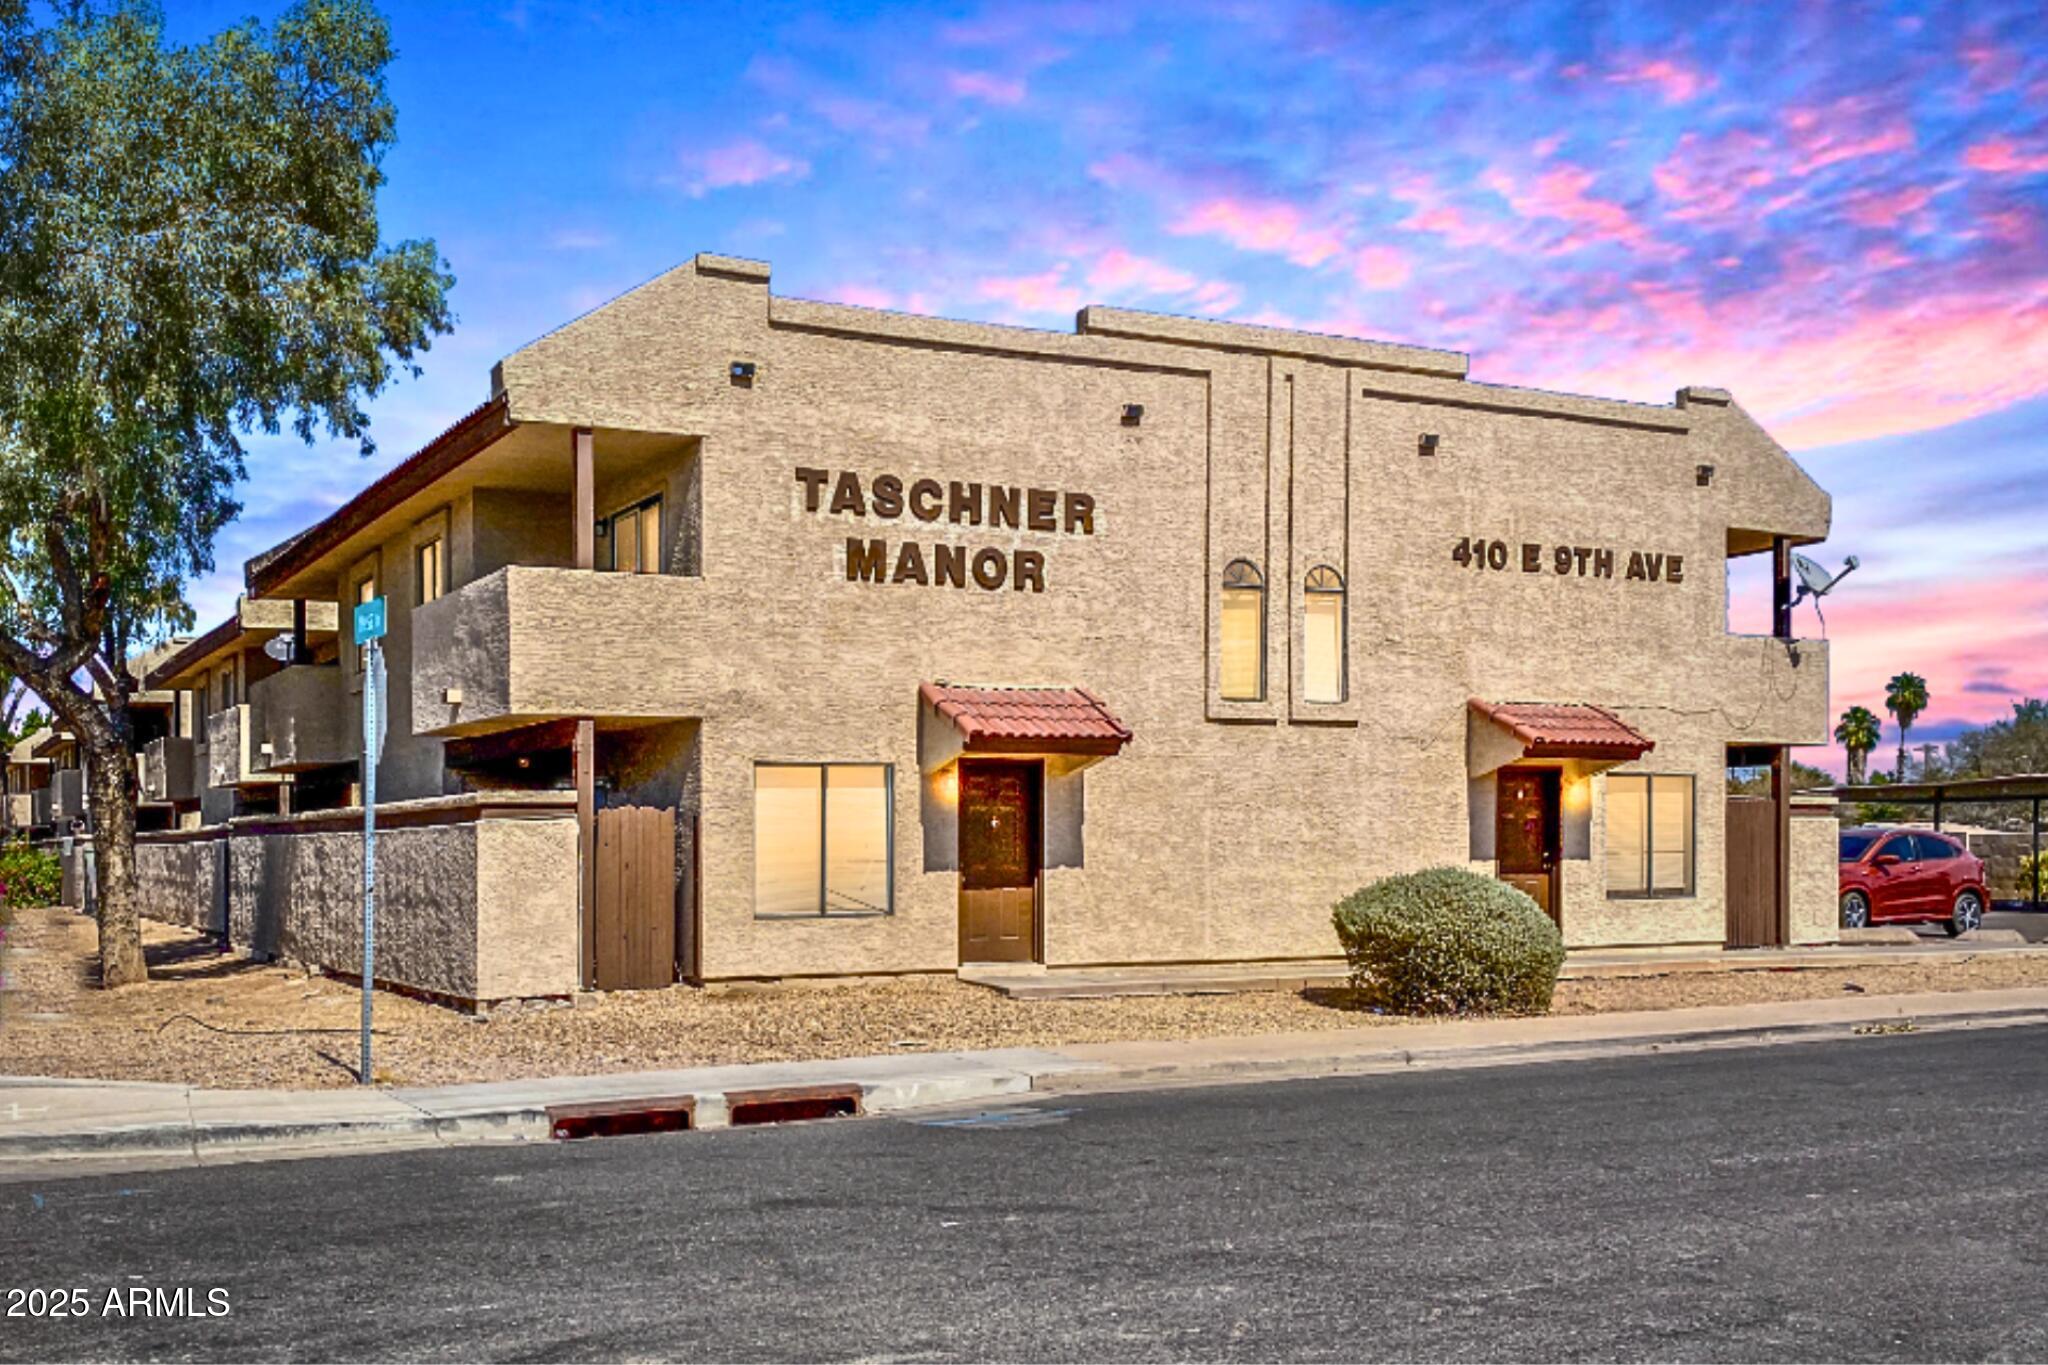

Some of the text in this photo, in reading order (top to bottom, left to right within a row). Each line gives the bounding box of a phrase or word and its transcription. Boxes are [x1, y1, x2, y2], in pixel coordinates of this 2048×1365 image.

[795, 466, 1096, 535] TASCHNER
[846, 537, 1045, 593] MANOR
[1452, 536, 1684, 584] 410 E 9TH AVE
